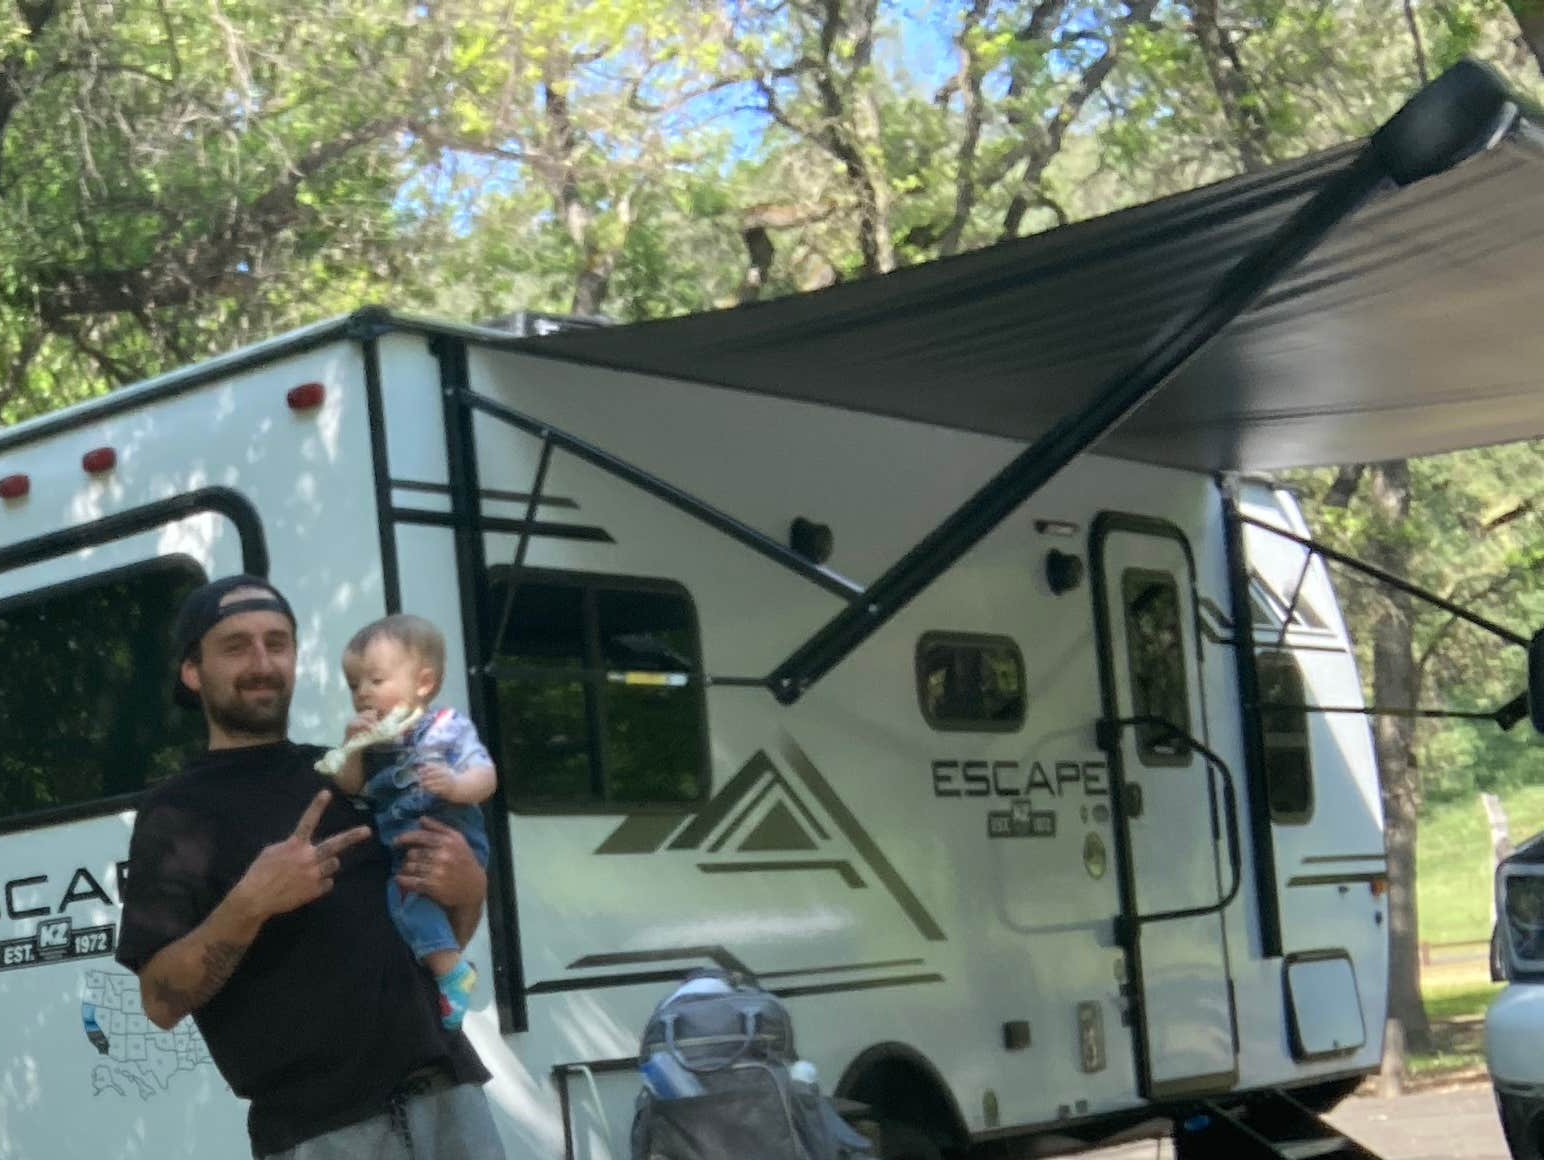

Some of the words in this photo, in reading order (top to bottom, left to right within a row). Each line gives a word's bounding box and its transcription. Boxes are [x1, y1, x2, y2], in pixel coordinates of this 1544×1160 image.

[931, 759, 1109, 797] ESCAPE
[3, 943, 35, 965] EST.
[74, 933, 108, 954] 1972
[39, 922, 68, 948] KZ
